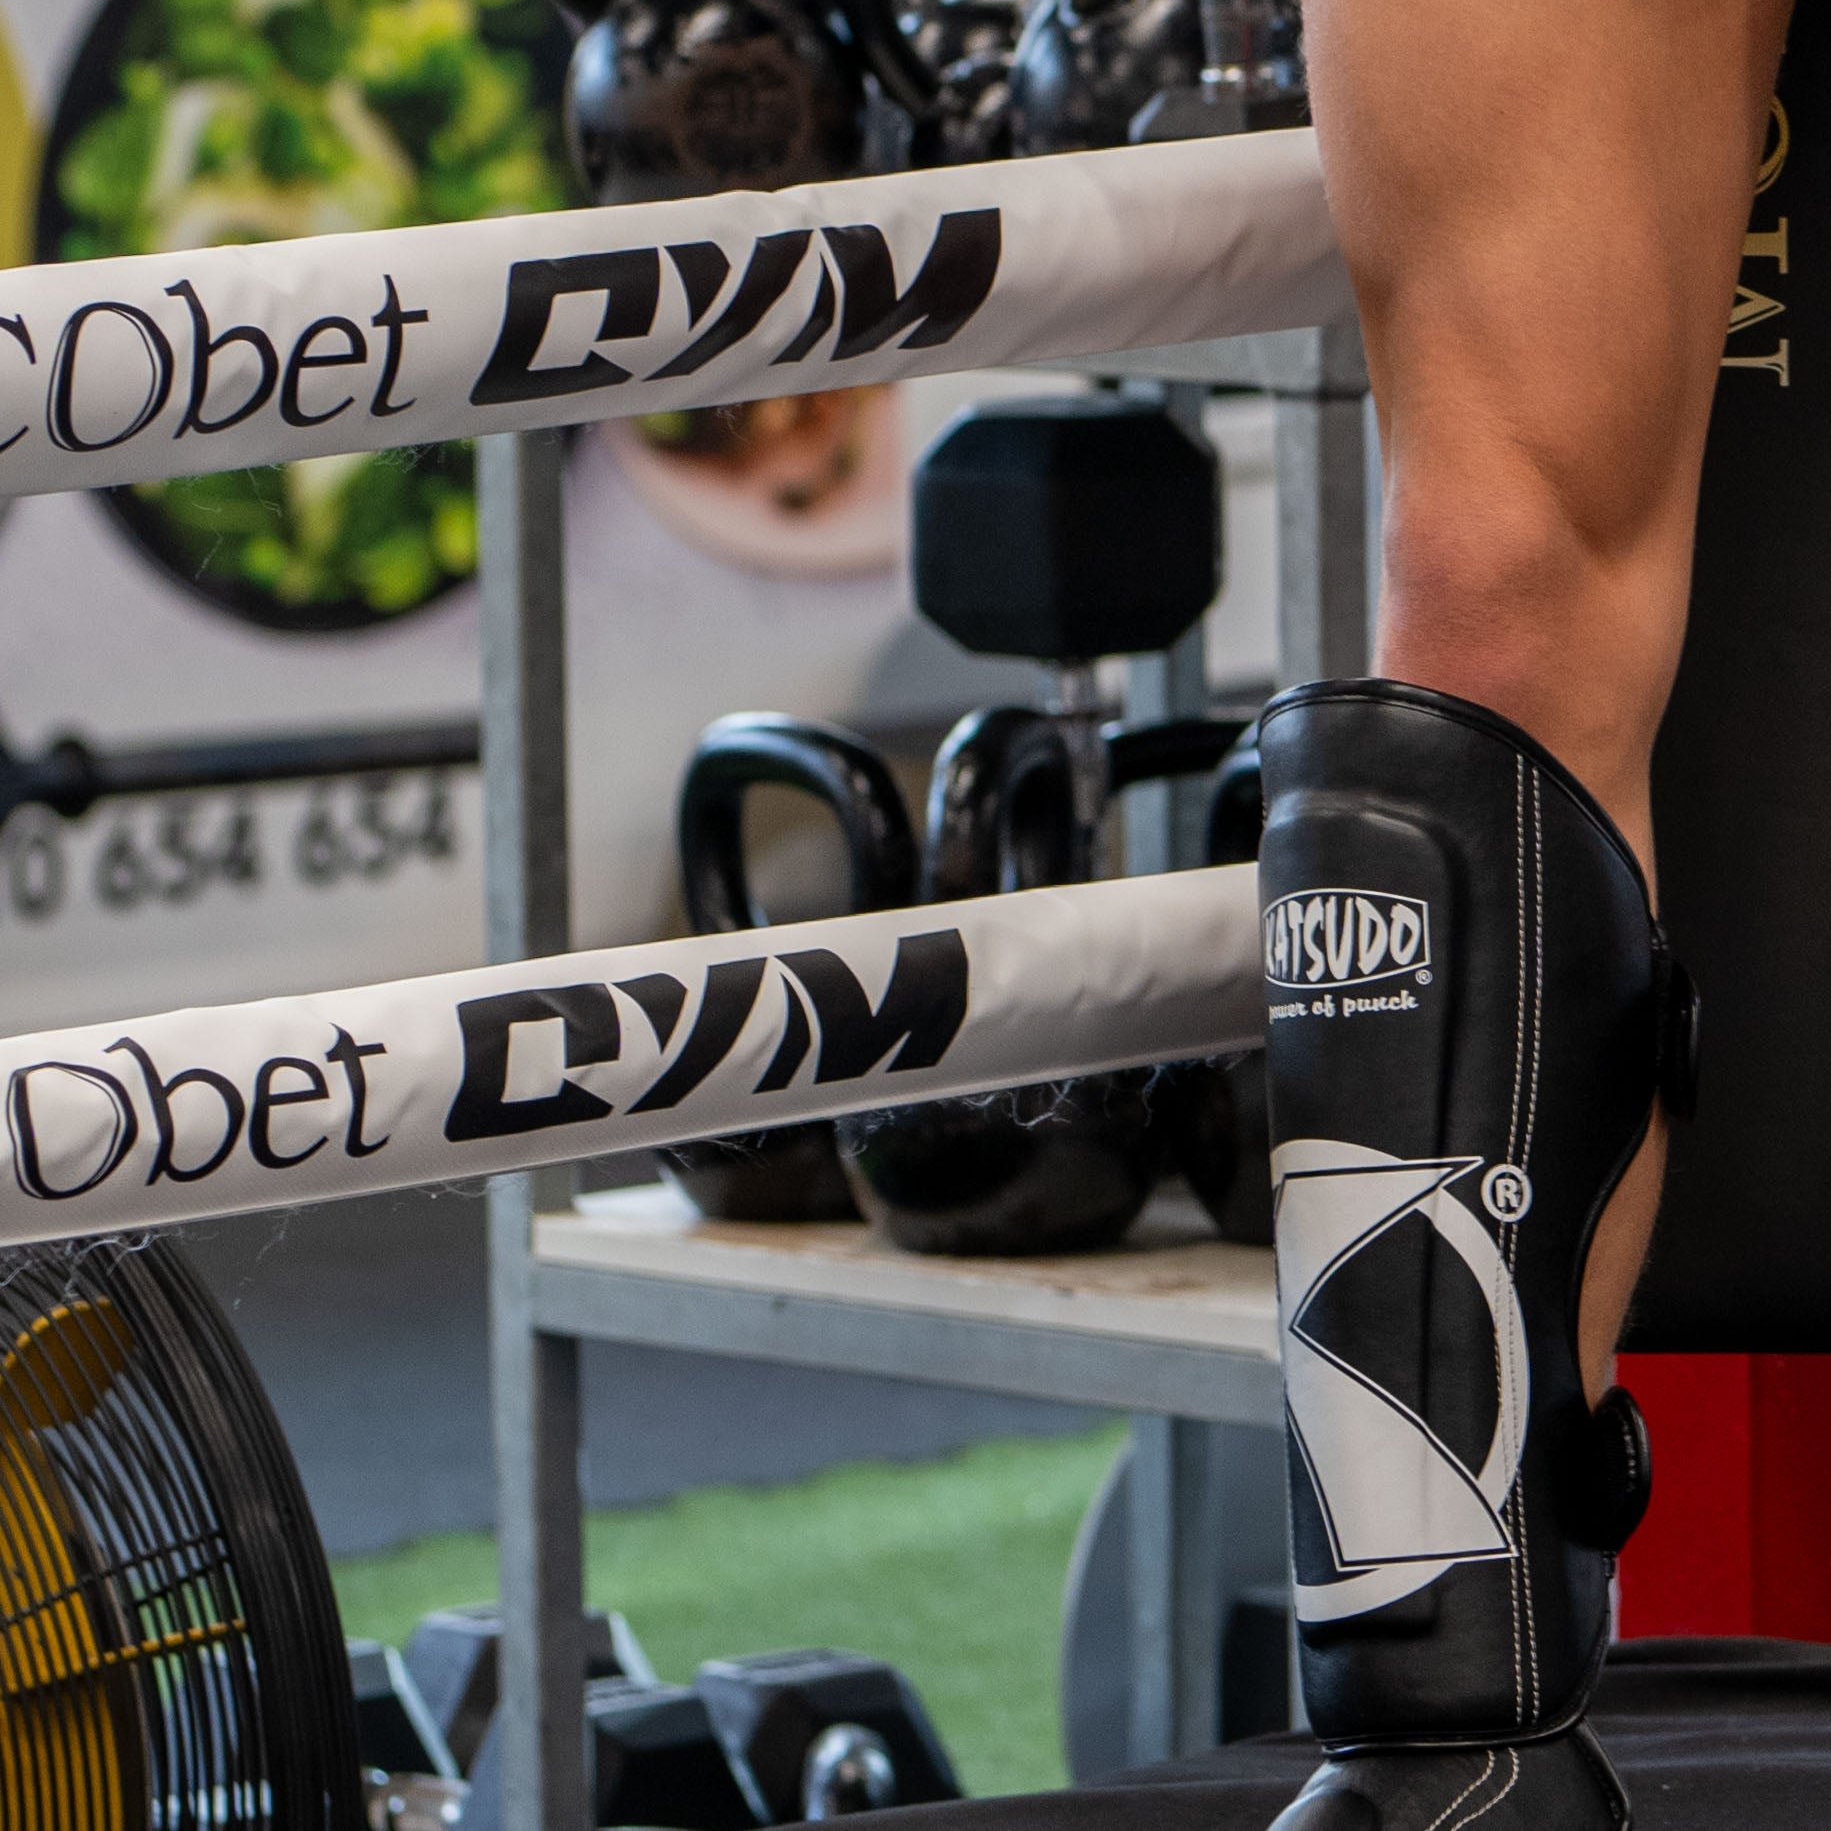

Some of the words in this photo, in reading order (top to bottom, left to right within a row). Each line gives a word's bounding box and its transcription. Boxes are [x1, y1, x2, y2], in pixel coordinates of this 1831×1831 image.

[0, 274, 430, 454] Obet
[469, 207, 1001, 407] GYM
[1265, 895, 1422, 982] KATSUDO
[1311, 993, 1337, 1018] of
[1342, 989, 1419, 1017] punch
[445, 928, 970, 1142] GYM
